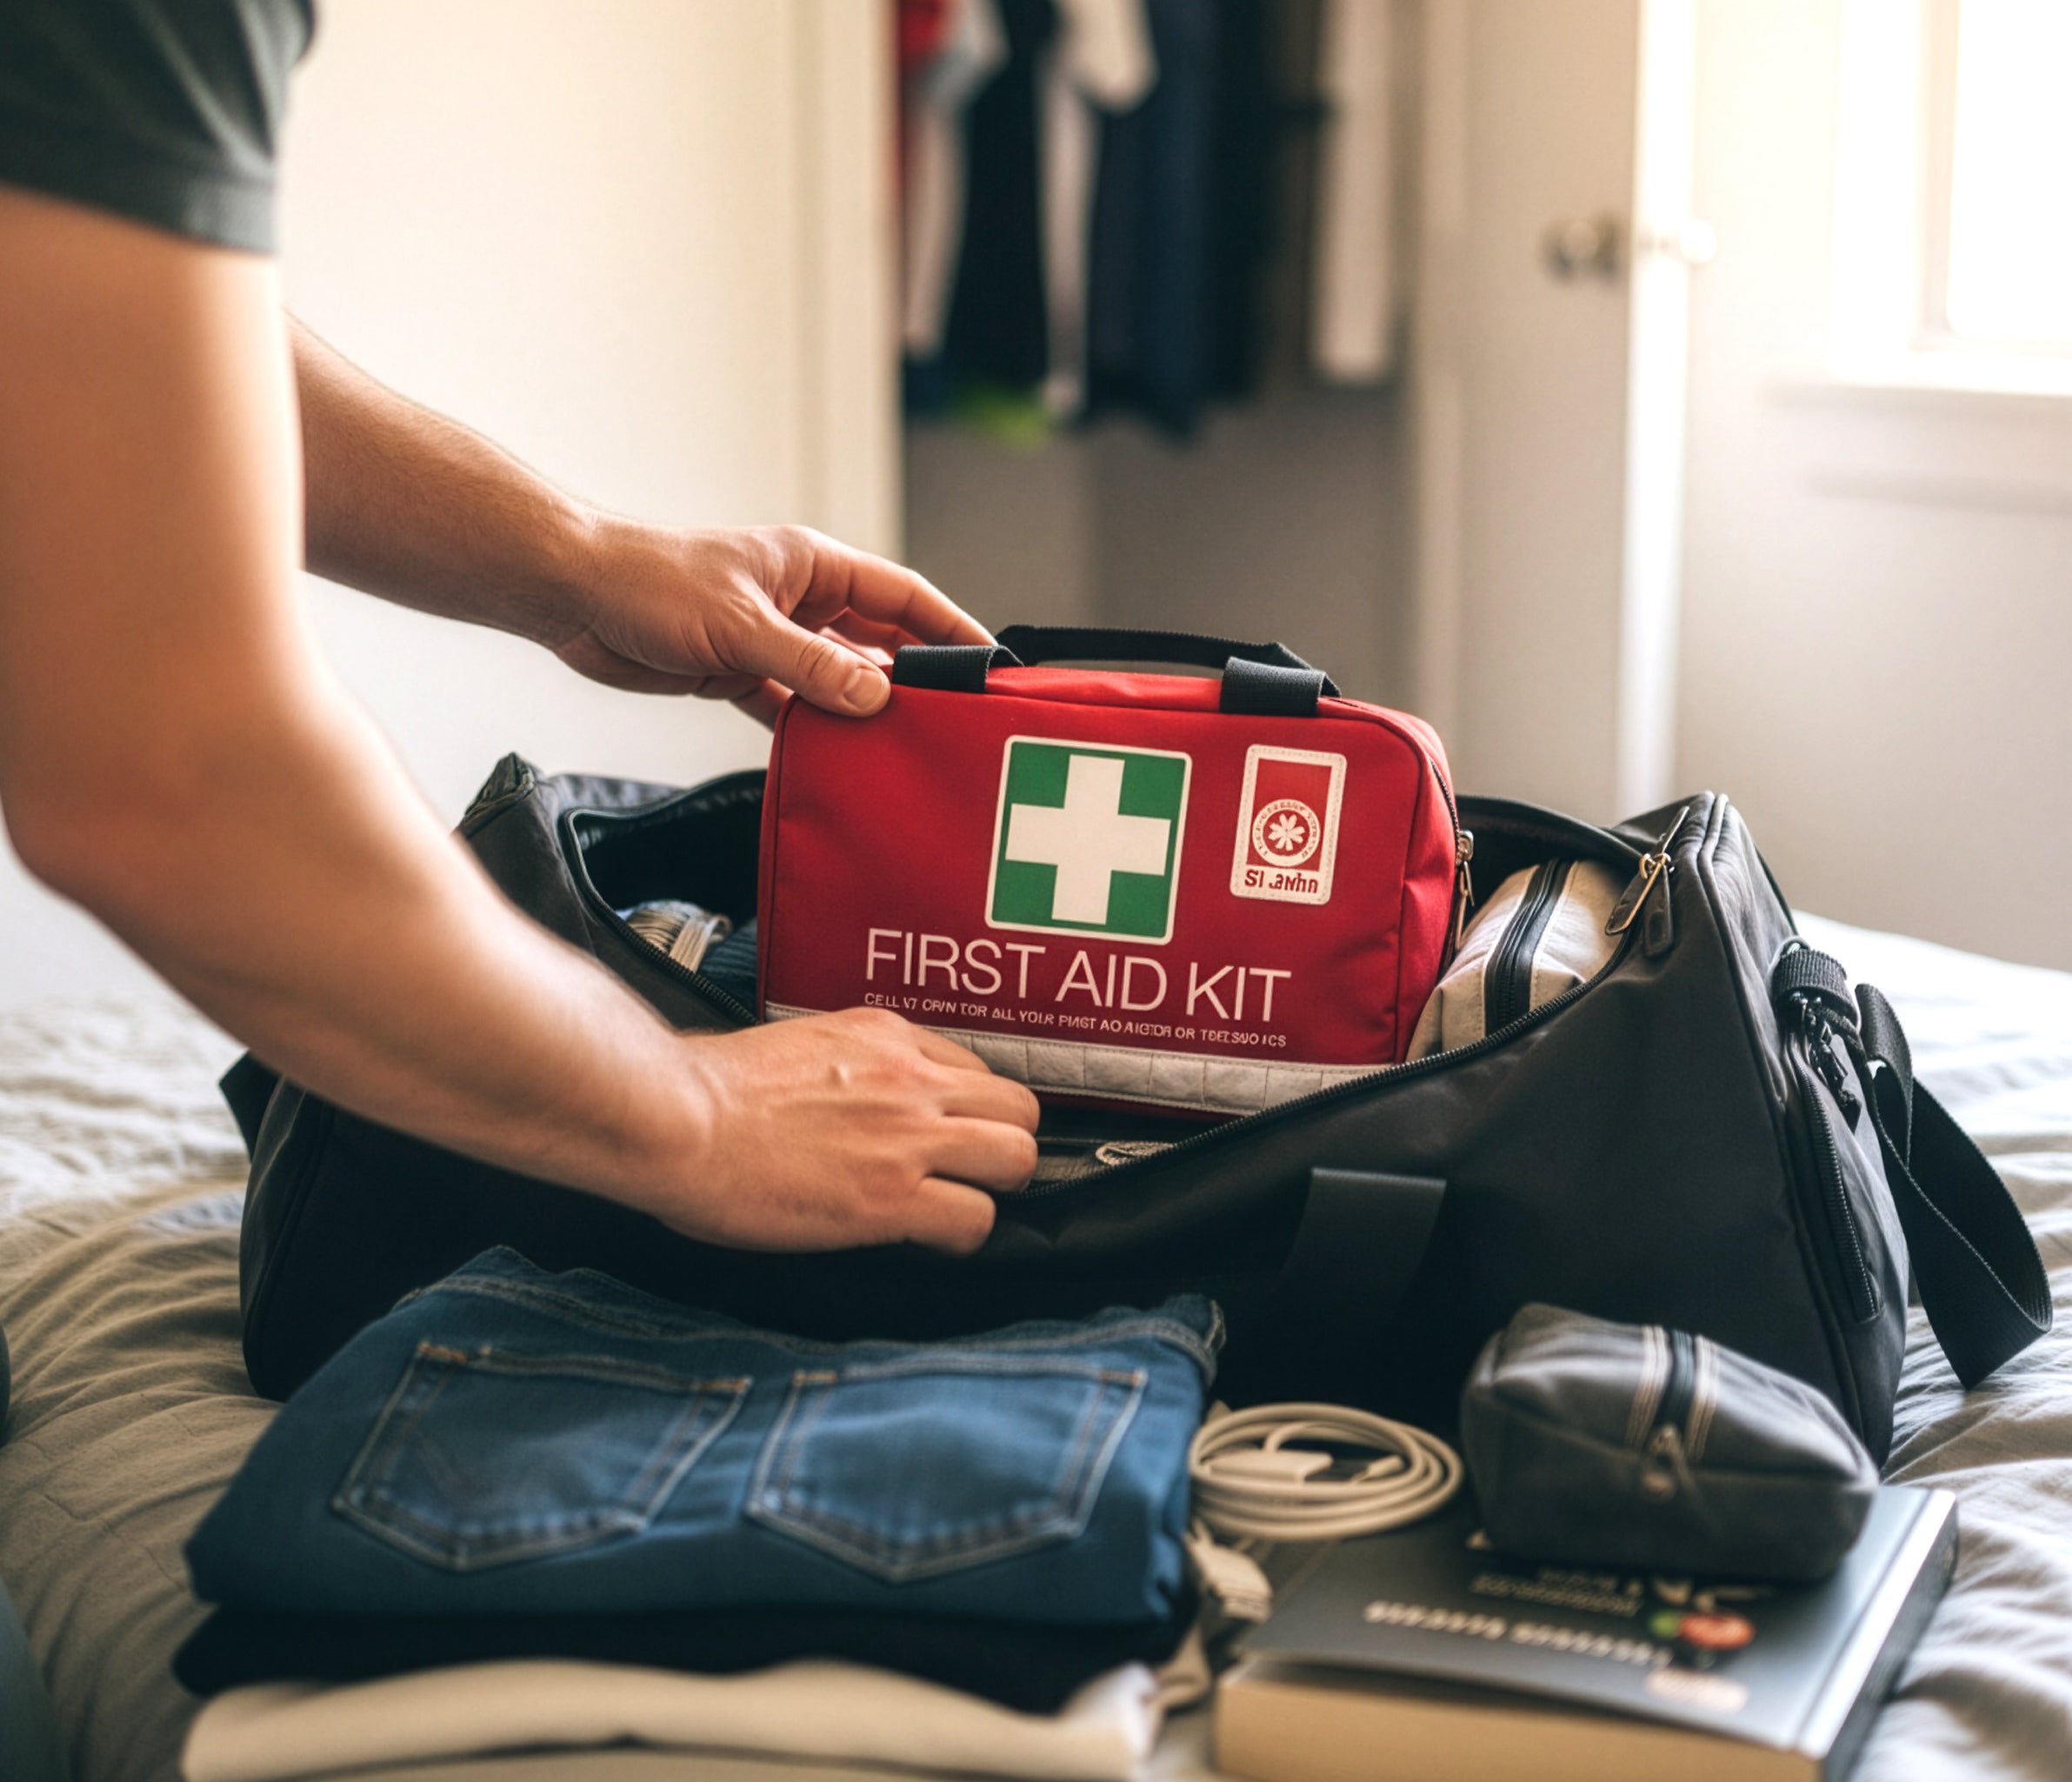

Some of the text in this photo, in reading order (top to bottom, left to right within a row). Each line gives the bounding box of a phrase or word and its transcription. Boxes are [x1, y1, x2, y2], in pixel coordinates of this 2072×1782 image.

[865, 928, 1292, 1023] FIRST AID KIT
[864, 992, 900, 1009] CELL
[991, 1007, 1016, 1021] ALL
[1175, 1026, 1196, 1040] OR
